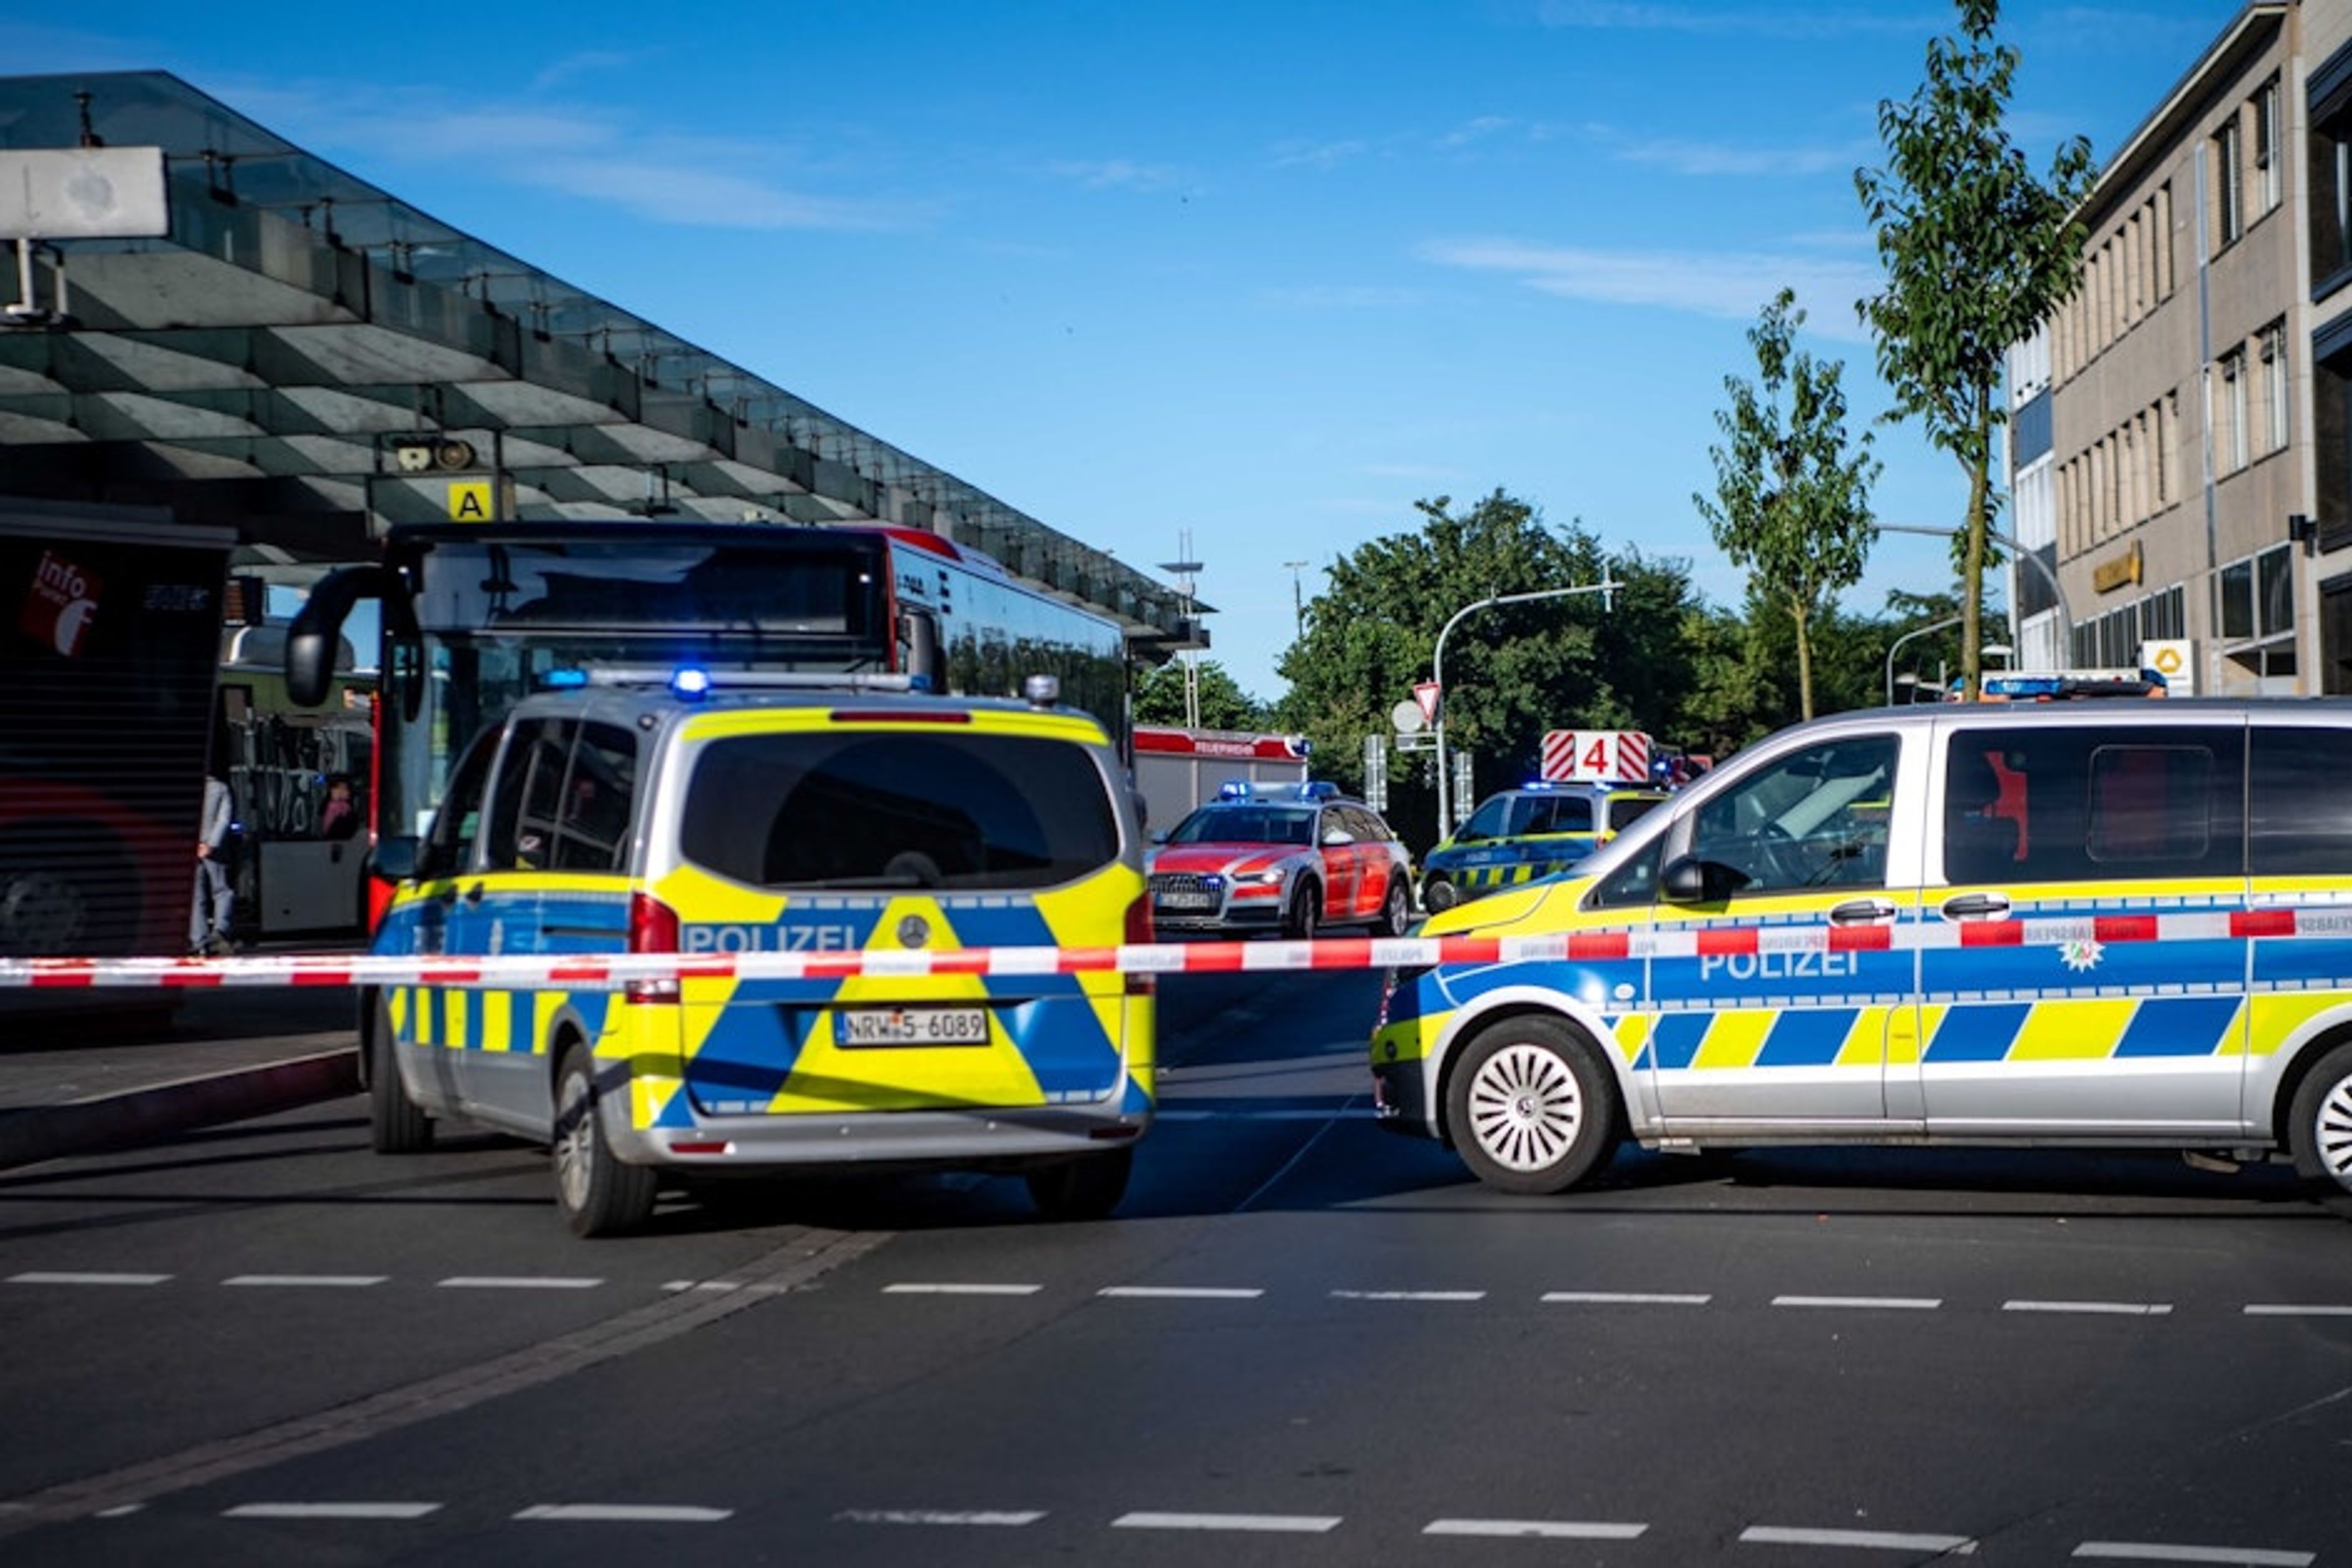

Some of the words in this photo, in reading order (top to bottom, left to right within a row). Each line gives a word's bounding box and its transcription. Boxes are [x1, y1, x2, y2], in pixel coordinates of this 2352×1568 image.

[458, 491, 484, 518] A
[37, 550, 87, 598] info
[1583, 739, 1608, 774] 4
[1701, 950, 1859, 981] POLIZEI
